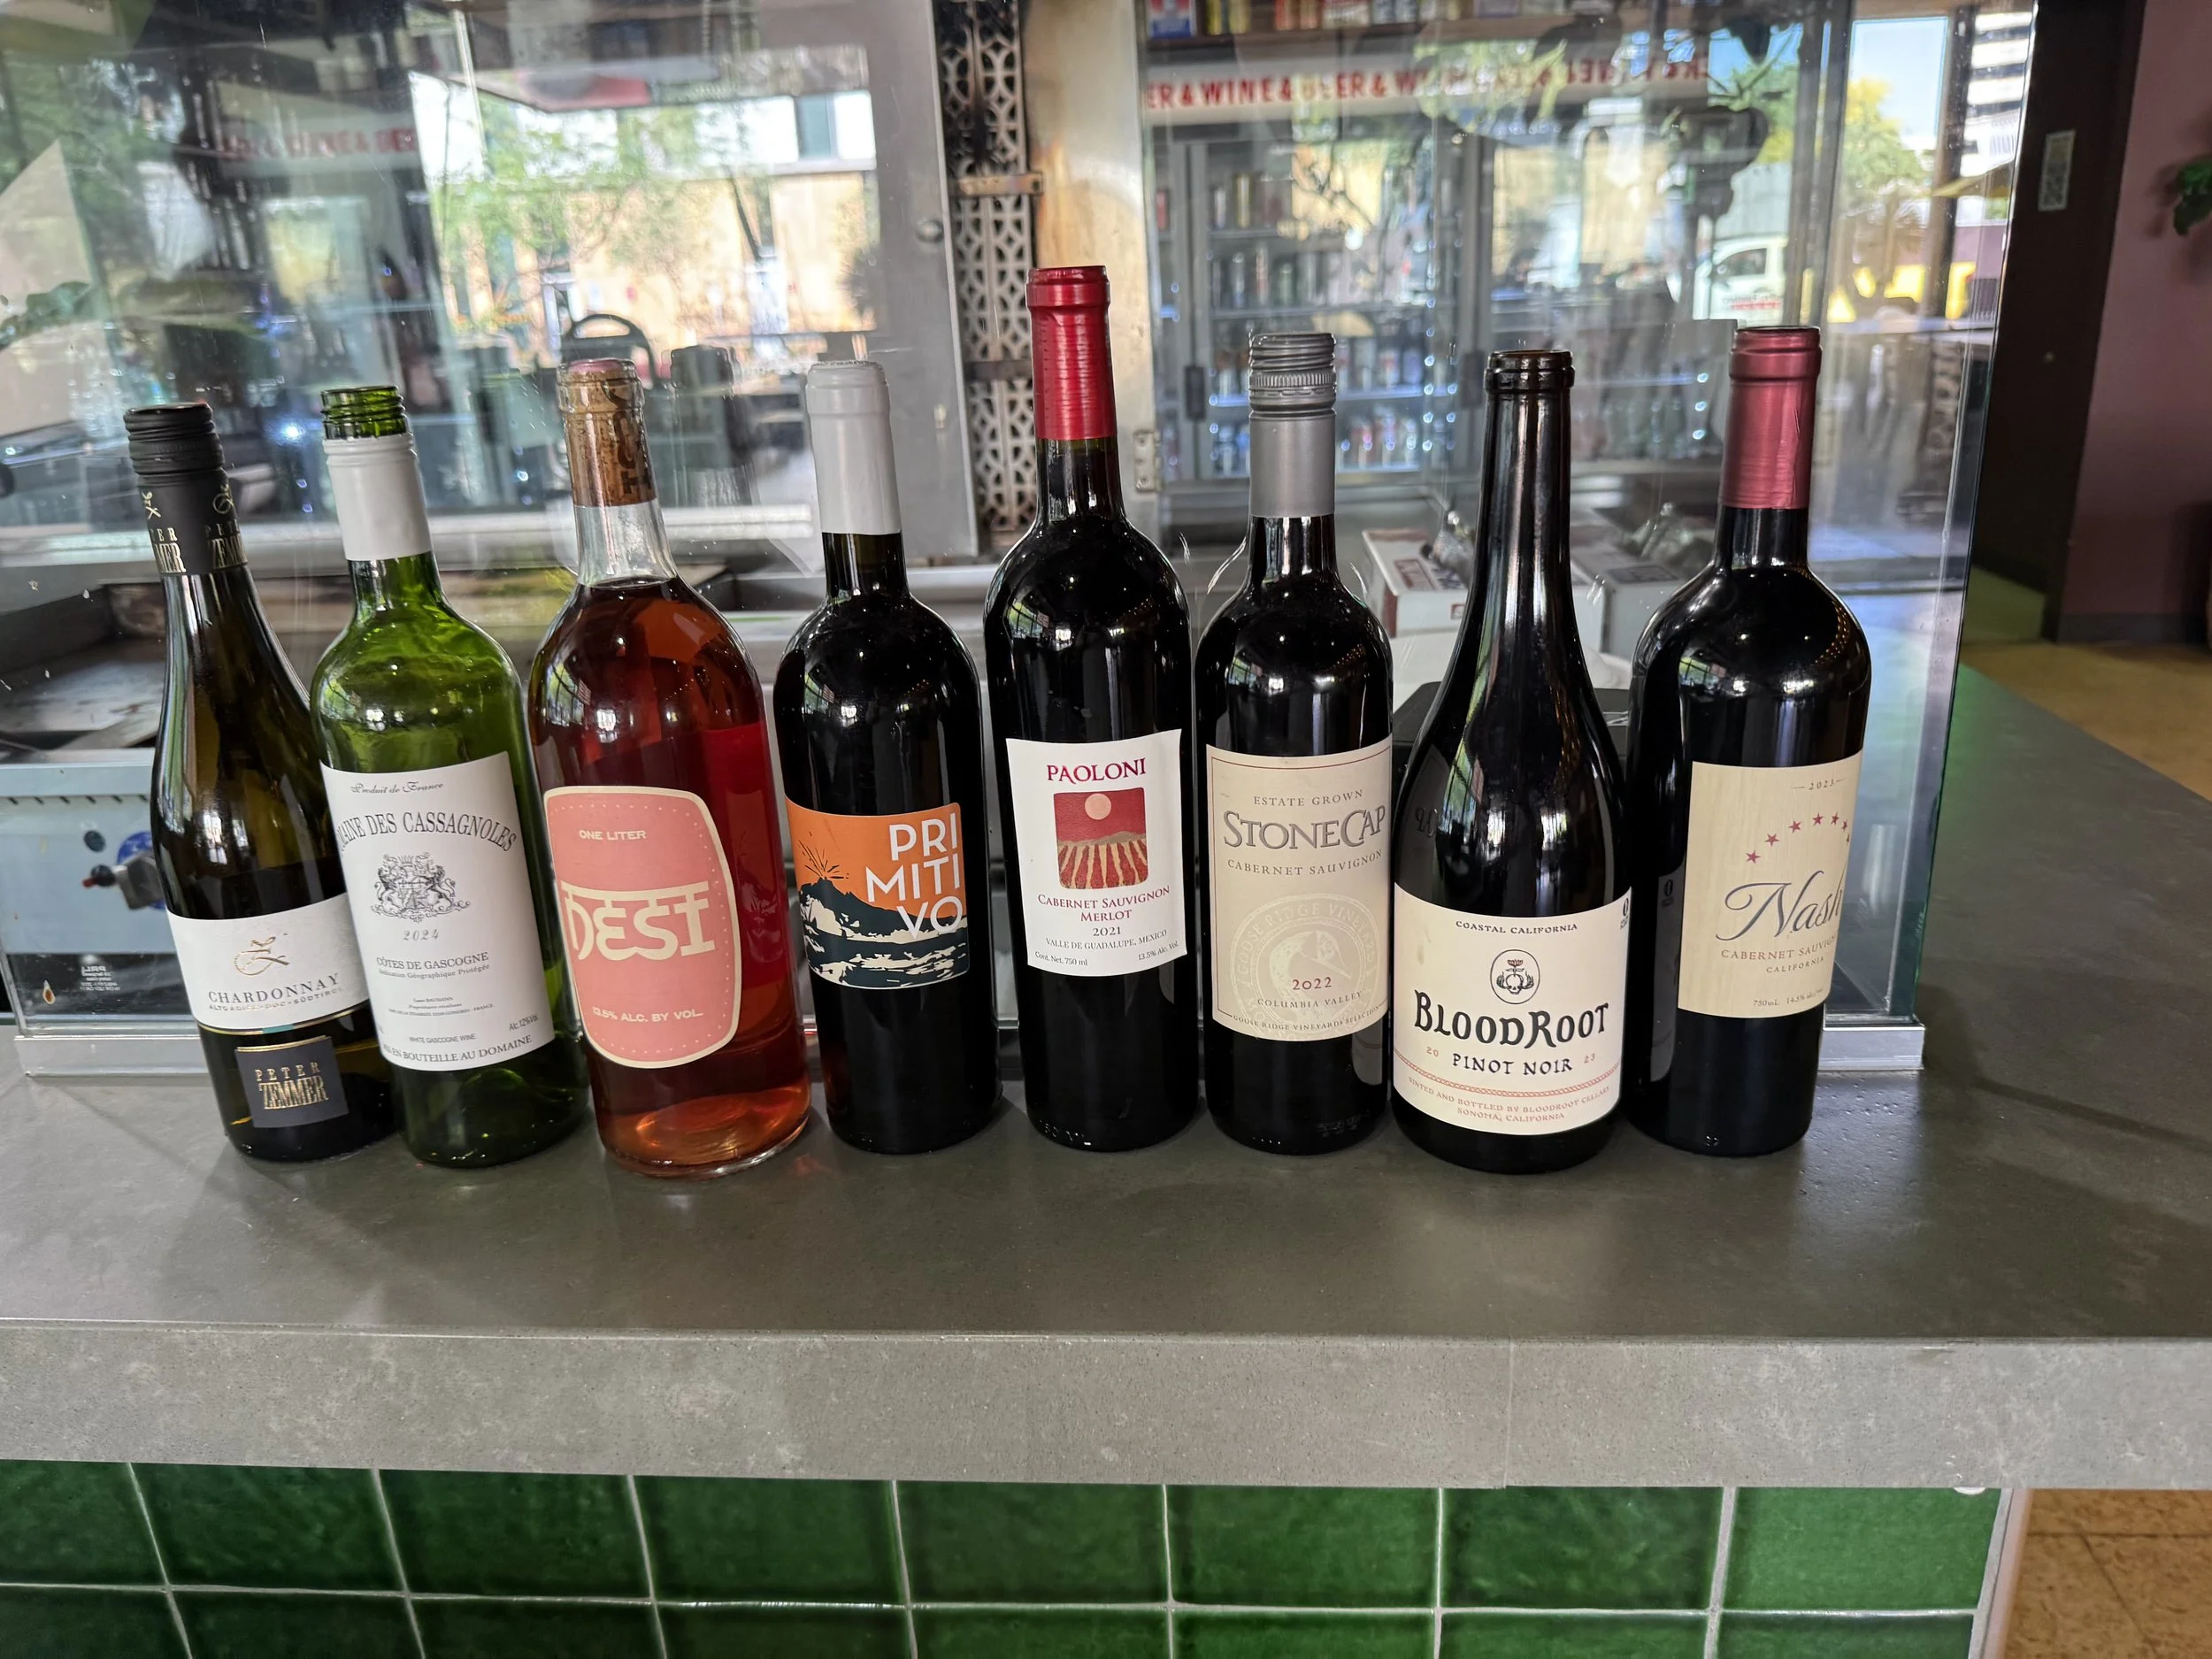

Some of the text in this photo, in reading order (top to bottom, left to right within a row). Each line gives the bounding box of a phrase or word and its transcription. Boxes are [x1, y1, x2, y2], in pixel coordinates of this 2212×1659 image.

[1200, 75, 1272, 107] WINE
[1047, 757, 1147, 785] PAOLONI
[388, 784, 400, 794] de
[1254, 789, 1363, 807] ESTATE GROWN
[365, 812, 397, 835] DES
[403, 811, 517, 852] CASSAGNOLES
[579, 830, 647, 841] ONE LITER
[889, 812, 958, 861] PRI
[1227, 849, 1382, 876] CABERNET SAUVIGNON
[865, 853, 961, 902] MITI
[1038, 885, 1171, 910] CABERNET SAUVIGNON
[1716, 861, 1847, 941] Nash
[896, 895, 964, 940] VO
[1080, 909, 1133, 922] MERLOT
[403, 929, 440, 941] 2024
[1093, 926, 1122, 937] 2021
[1455, 920, 1578, 934] COASTAL CALIFORNIA
[1046, 938, 1070, 949] VALLE
[1138, 929, 1167, 945] MEXICO
[407, 961, 422, 970] DE
[425, 951, 489, 970] GASCOGNE
[1138, 950, 1156, 961] 13.5%
[1721, 949, 1794, 961] CABERNET
[1766, 956, 1824, 973] CALIFORNIA
[208, 973, 340, 1004] CHARDONNAY
[1292, 977, 1333, 990] 2022
[1257, 990, 1363, 1008] COLUMBIA VALLEY
[651, 1012, 670, 1022] BY
[1262, 1022, 1290, 1031] RIDGE
[403, 1051, 458, 1062] BOUTEILLE
[461, 1050, 476, 1061] AU
[479, 1034, 533, 1057] DOMAINE
[1426, 1046, 1596, 1075] 20 PINOT NOIR 23
[256, 1062, 320, 1081] PETER
[258, 1074, 329, 1110] ZEMMER
[1436, 1091, 1455, 1102] AND
[1457, 1098, 1503, 1110] BOTTLED
[1523, 1099, 1579, 1113] BLOODROOT
[1506, 1113, 1565, 1123] CALIFORNIA
